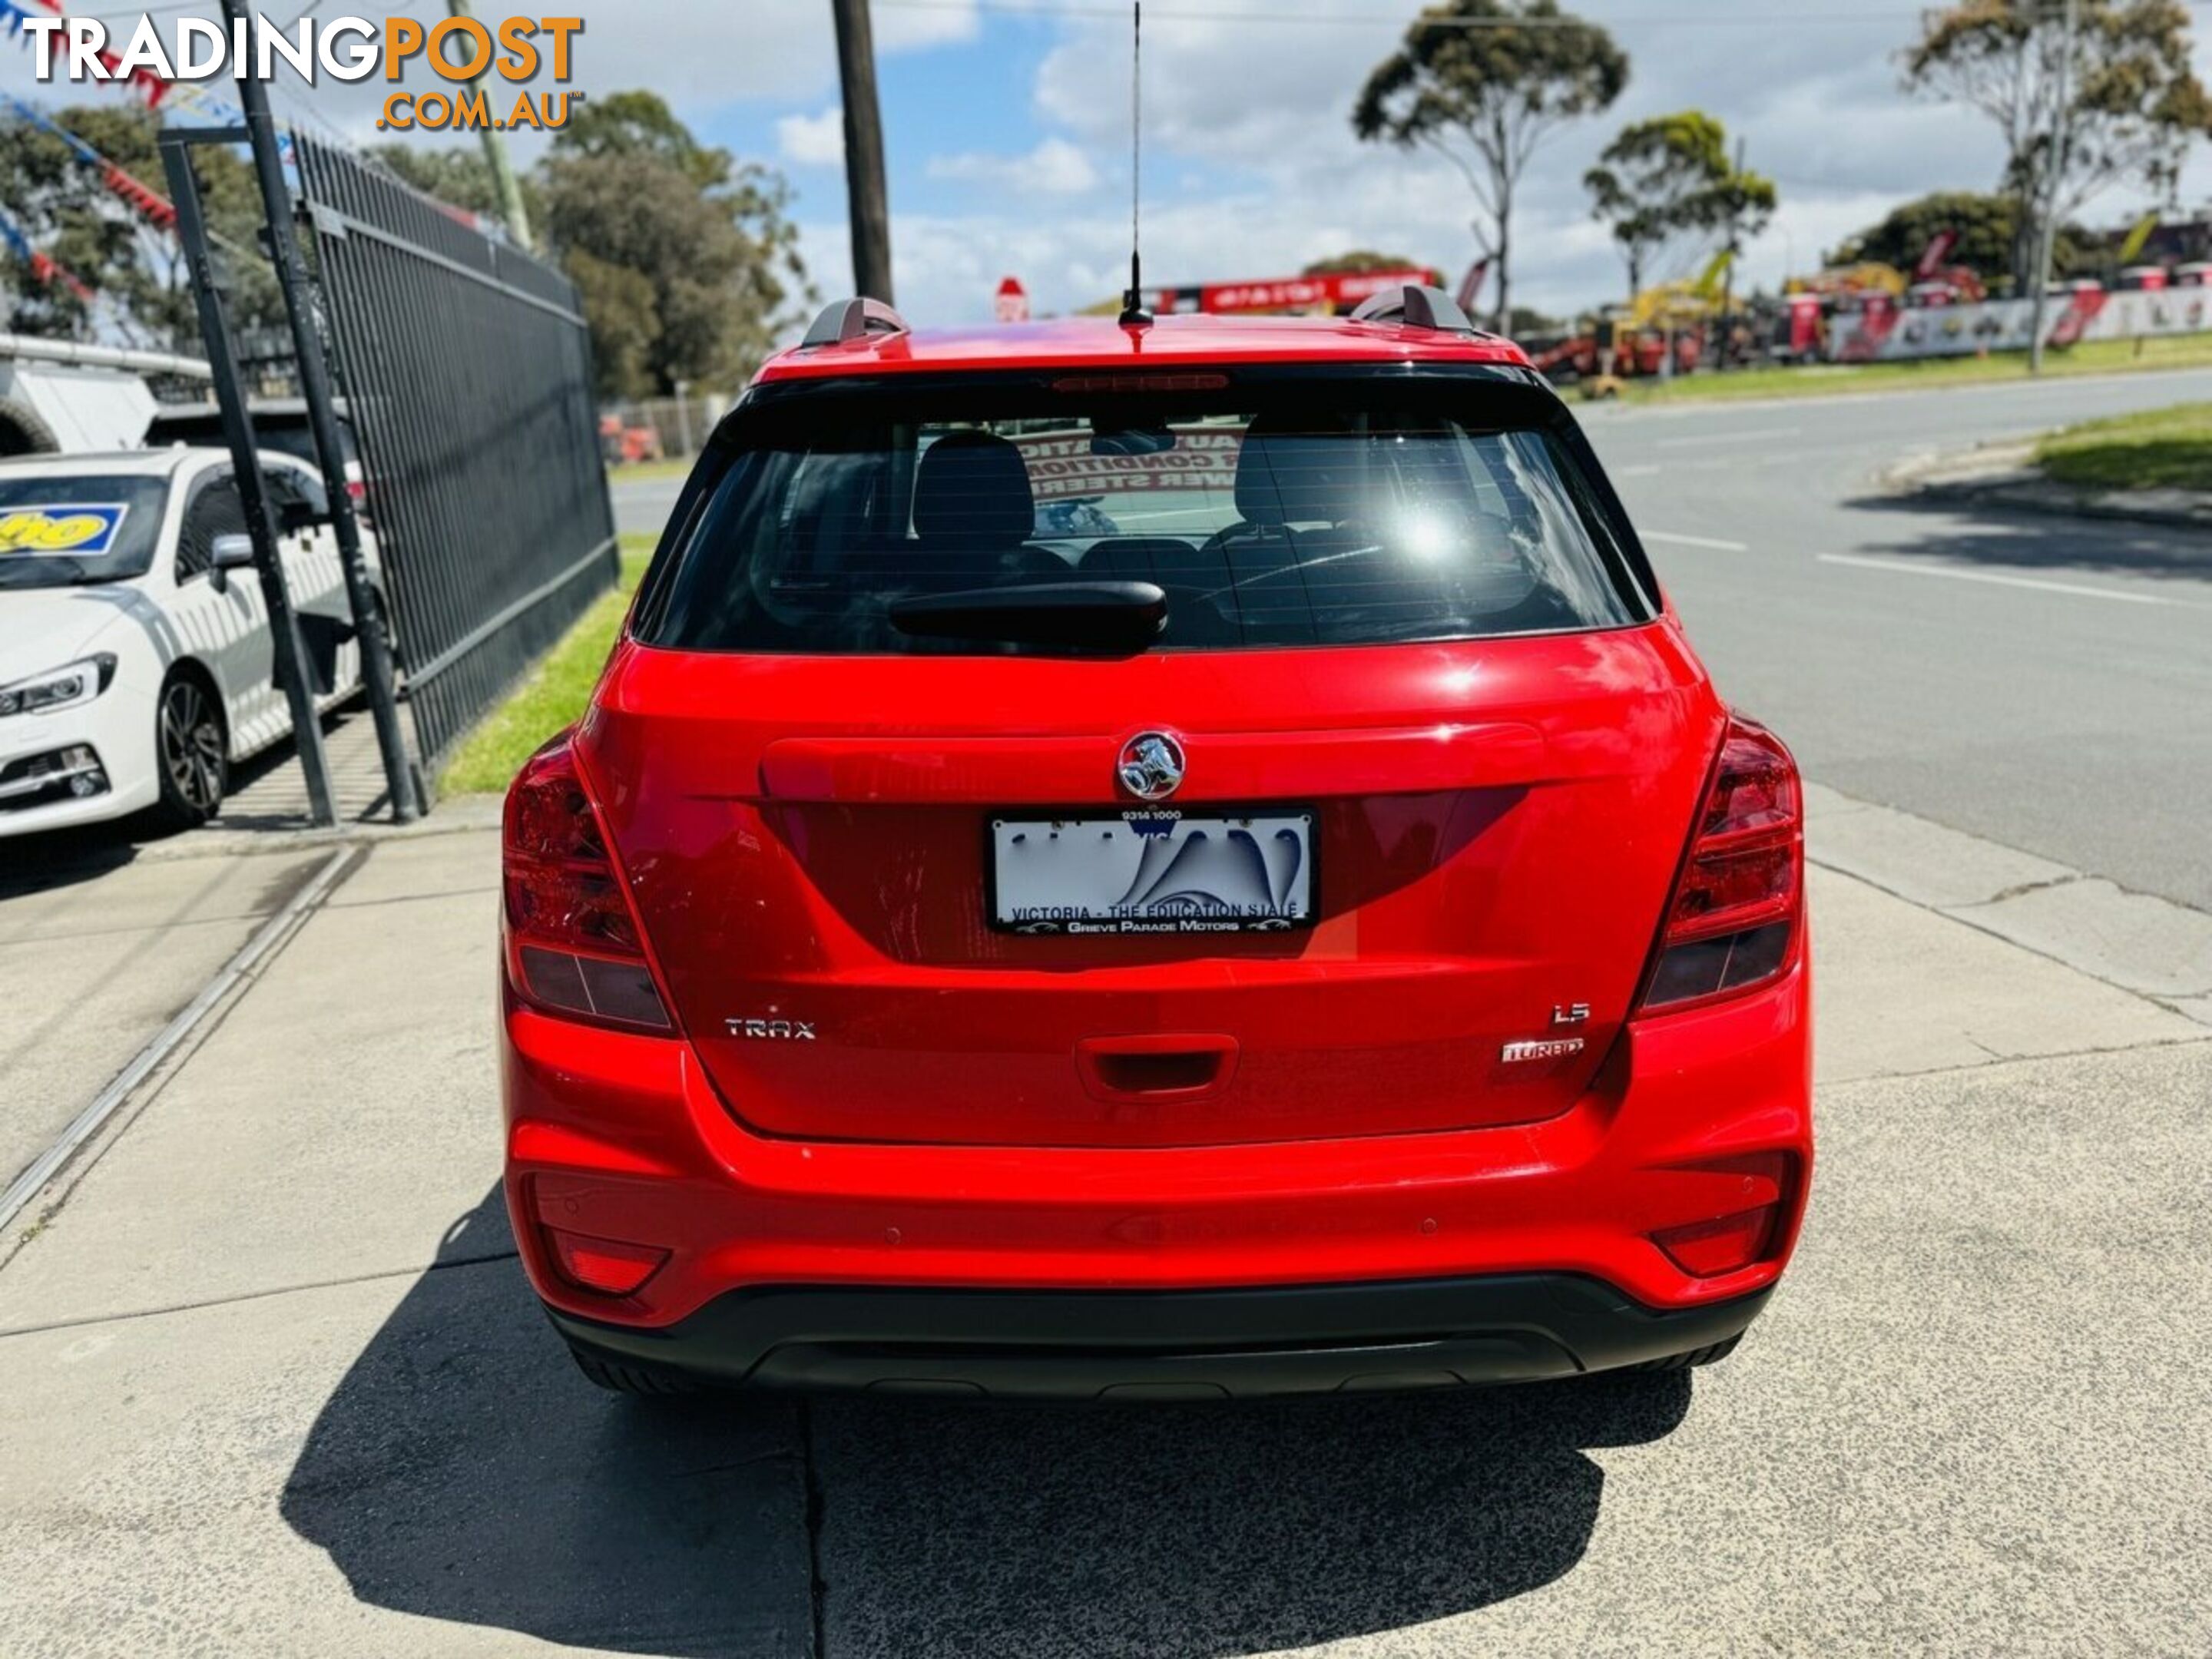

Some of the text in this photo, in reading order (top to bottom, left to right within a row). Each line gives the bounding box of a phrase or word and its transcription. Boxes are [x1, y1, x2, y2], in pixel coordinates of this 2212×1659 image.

[1122, 810, 1182, 820] 9314 1000
[1012, 906, 1091, 921] VICTORIA
[1108, 905, 1140, 919] THE
[1147, 904, 1242, 918] EDUCATION
[725, 1018, 816, 1039] TRAX
[1502, 1038, 1584, 1063] TURBO
